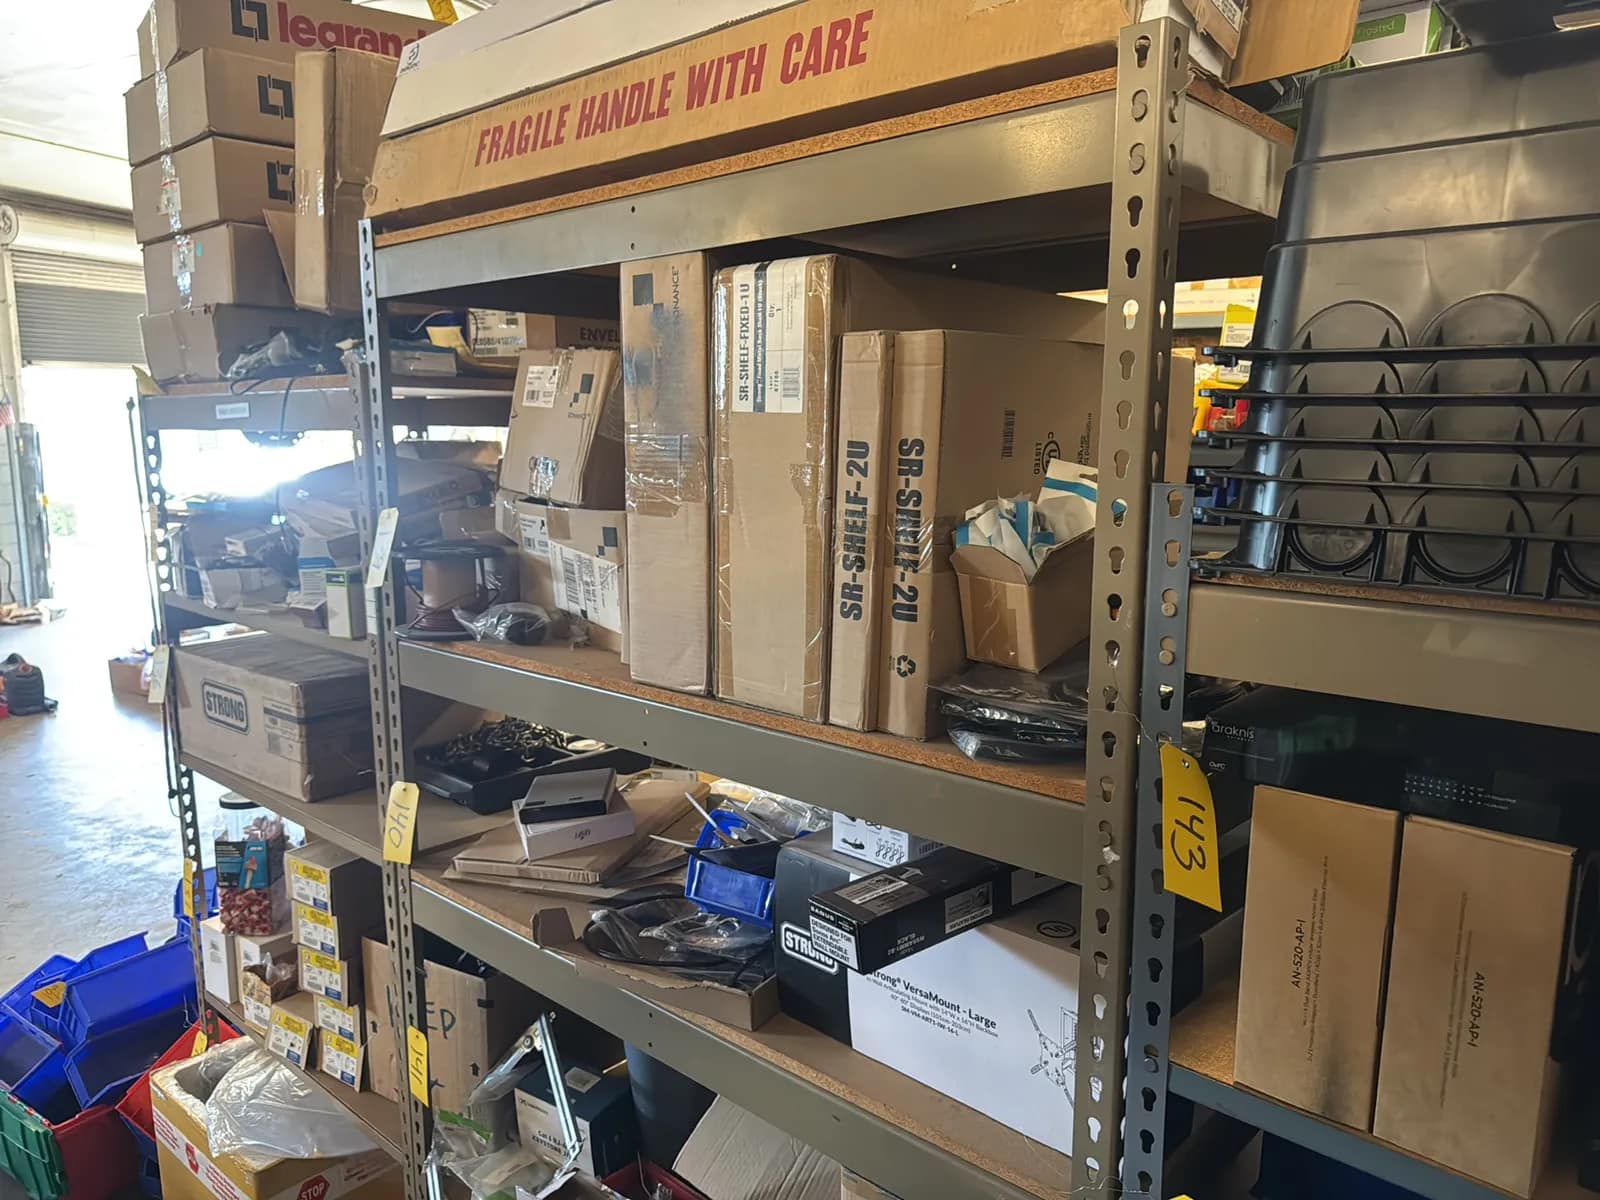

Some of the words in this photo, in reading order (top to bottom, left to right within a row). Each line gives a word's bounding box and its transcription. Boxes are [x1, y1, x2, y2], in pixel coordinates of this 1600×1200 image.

[474, 103, 571, 168] FRAGILE
[577, 71, 675, 140] HANDLE
[685, 43, 767, 110] WITH
[781, 9, 873, 85] CARE
[739, 283, 749, 400] SR-SHELF-FIXED-1U
[1033, 442, 1042, 475] LISTED
[840, 440, 871, 621] SR-SHELF-2U
[891, 437, 926, 623] SR-SHELF-2U
[205, 691, 245, 723] STRONG
[1211, 723, 1255, 739] araknis
[387, 799, 411, 848] 140
[1170, 796, 1207, 871] 143
[902, 979, 961, 1012] VersaMount
[966, 1008, 996, 1029] Large
[410, 1043, 425, 1085] 141
[300, 1182, 326, 1200] STOP
